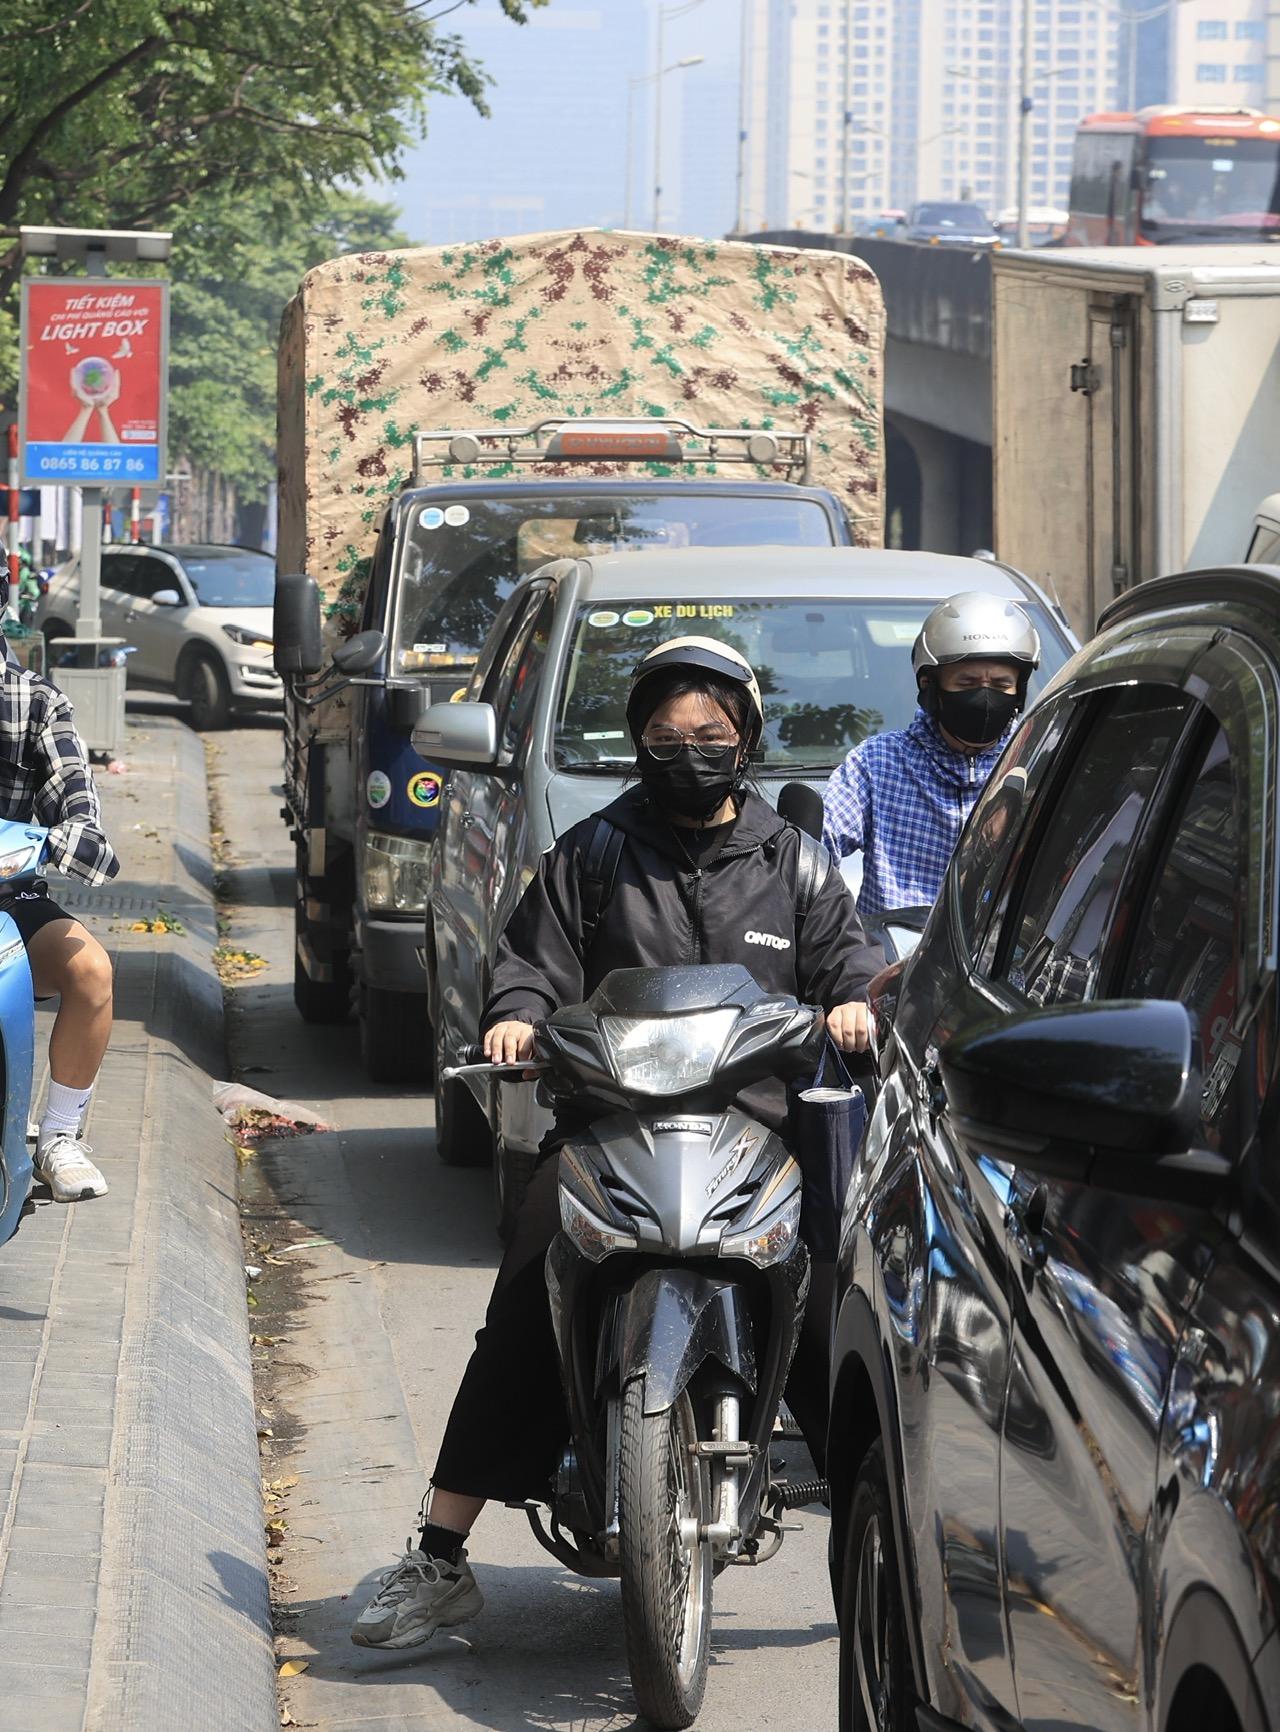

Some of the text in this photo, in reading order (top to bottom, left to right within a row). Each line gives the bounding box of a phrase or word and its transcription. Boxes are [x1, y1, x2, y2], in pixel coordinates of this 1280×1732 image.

[65, 293, 96, 310] TIẾT
[40, 319, 149, 341] LIGHT BOX
[40, 457, 144, 471] 0865 86 87 86
[654, 605, 672, 618] XE
[677, 605, 696, 618] DU
[700, 605, 733, 619] LỊCH
[744, 930, 791, 950] ONTOP
[654, 1122, 712, 1134] HONDA
